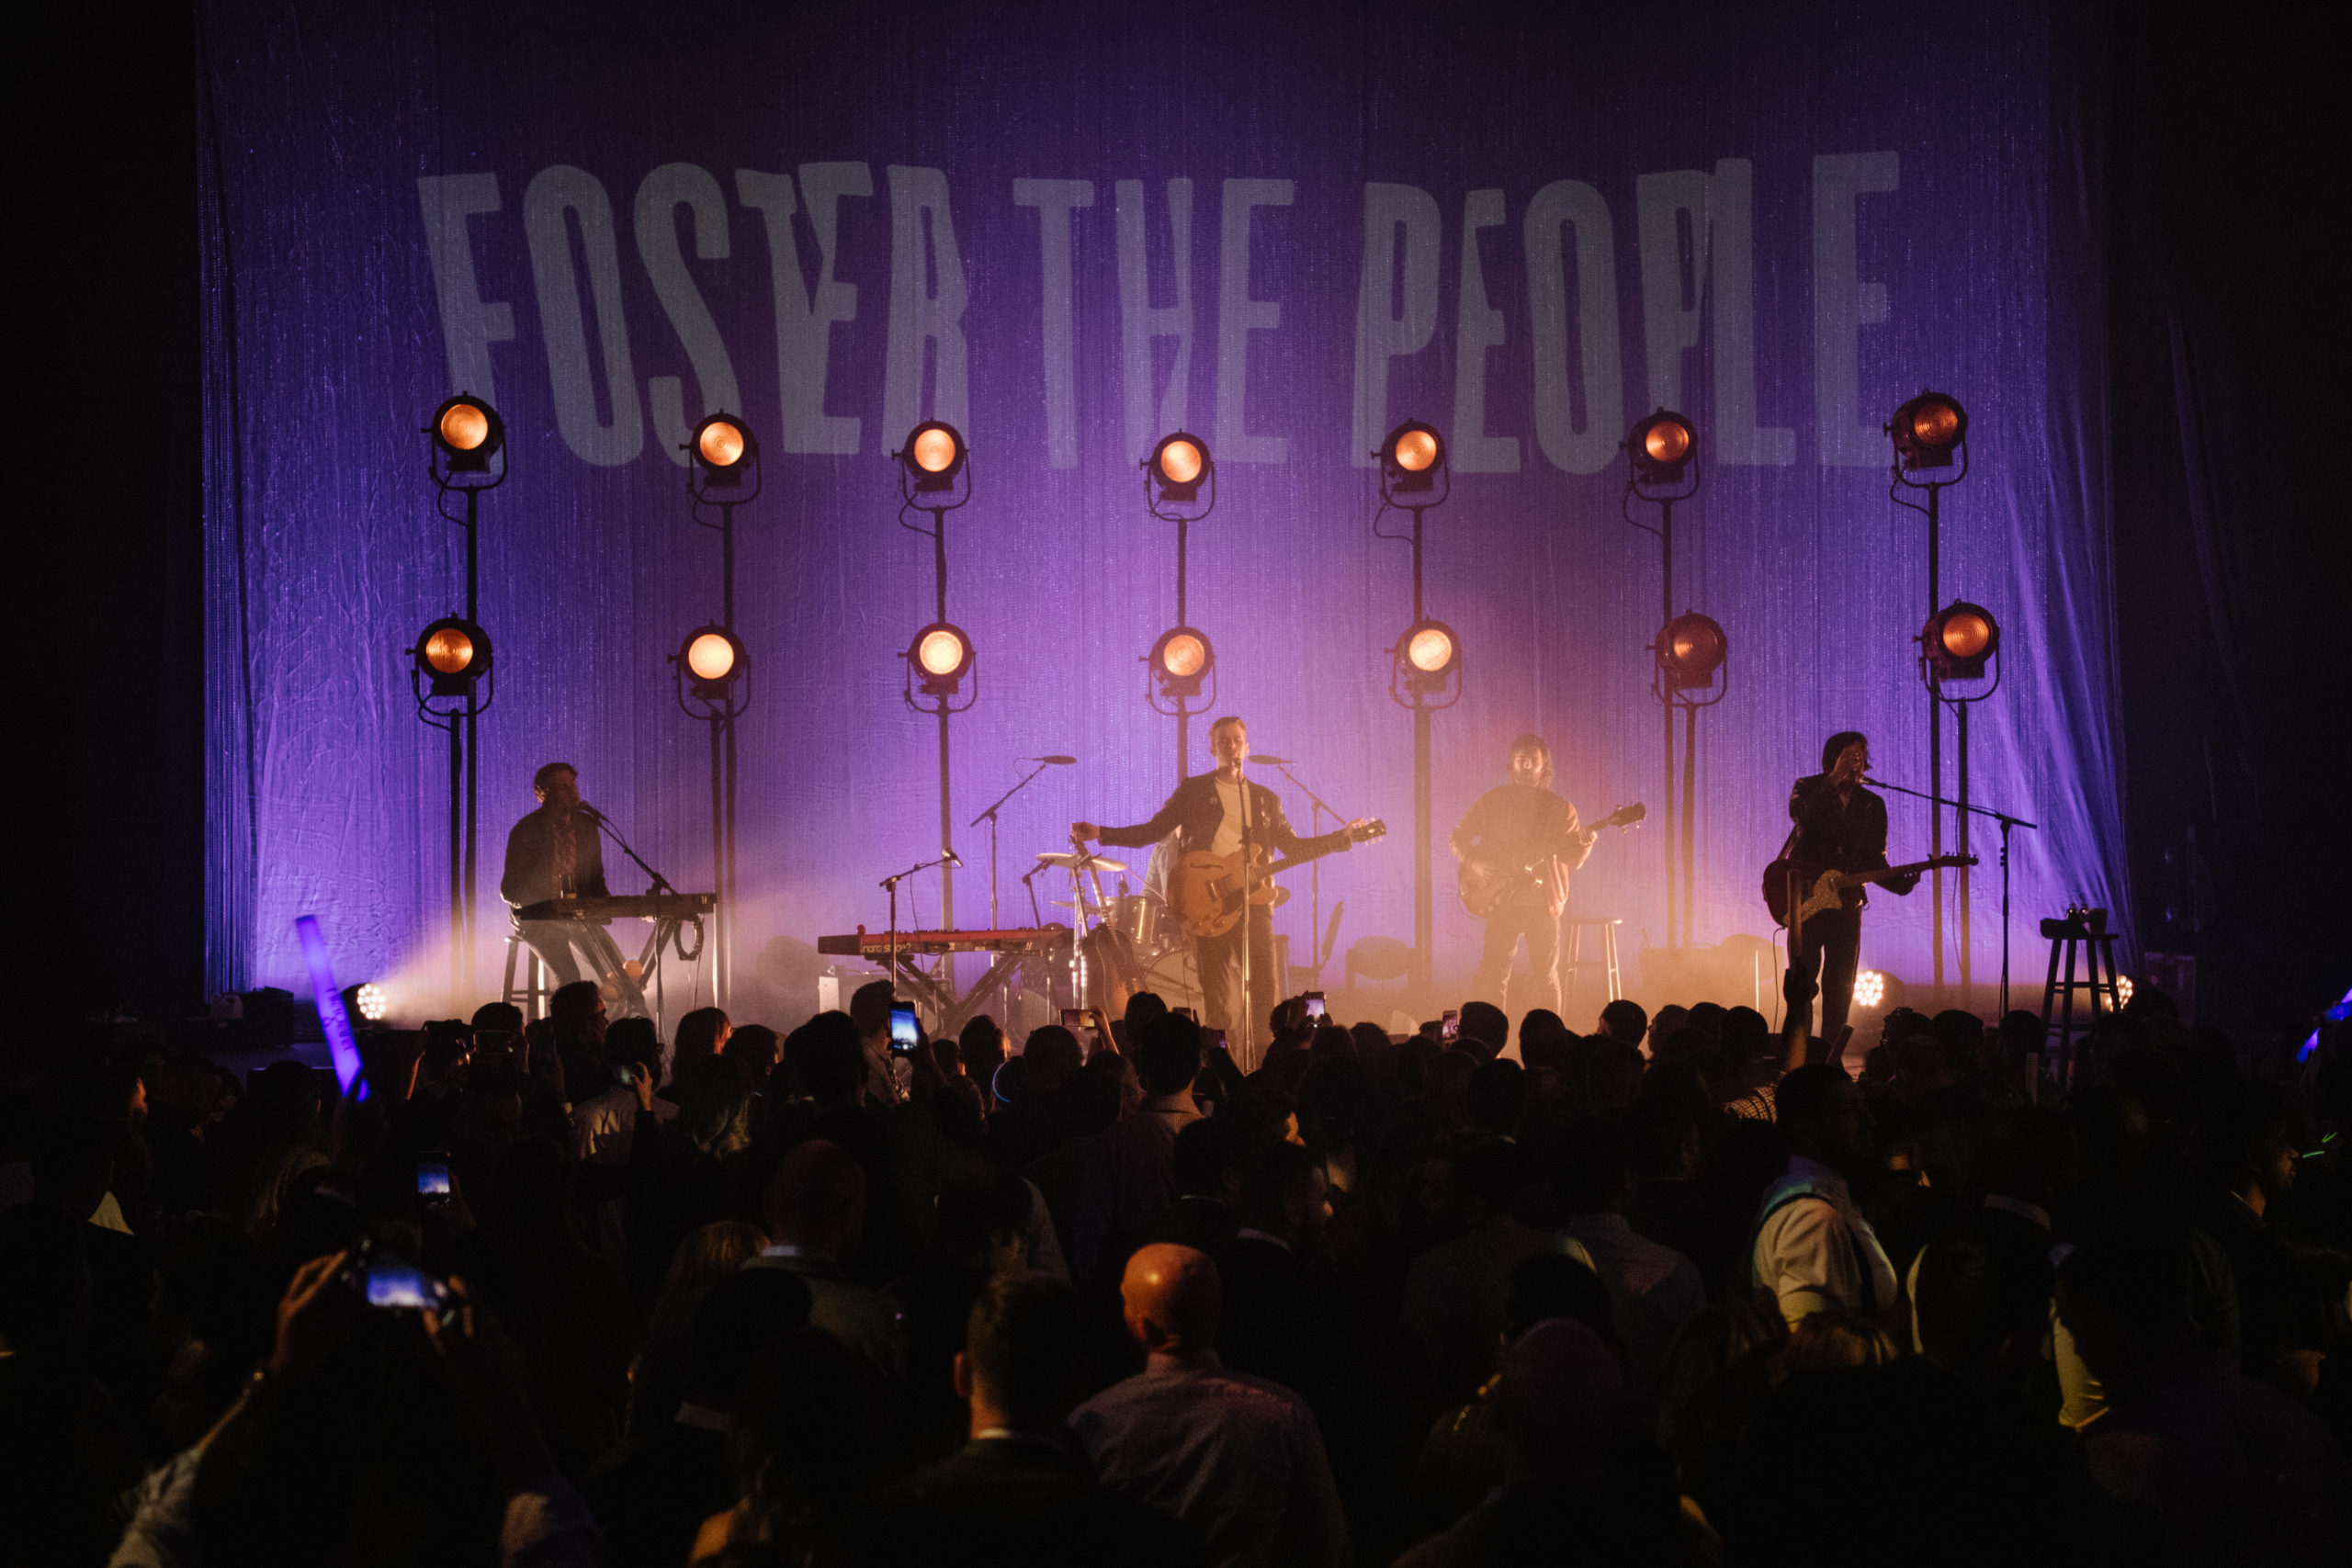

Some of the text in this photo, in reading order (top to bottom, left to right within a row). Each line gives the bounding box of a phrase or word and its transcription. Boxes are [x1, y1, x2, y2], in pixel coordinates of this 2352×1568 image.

[417, 151, 1899, 476] FOSTER THE PEOPLE
